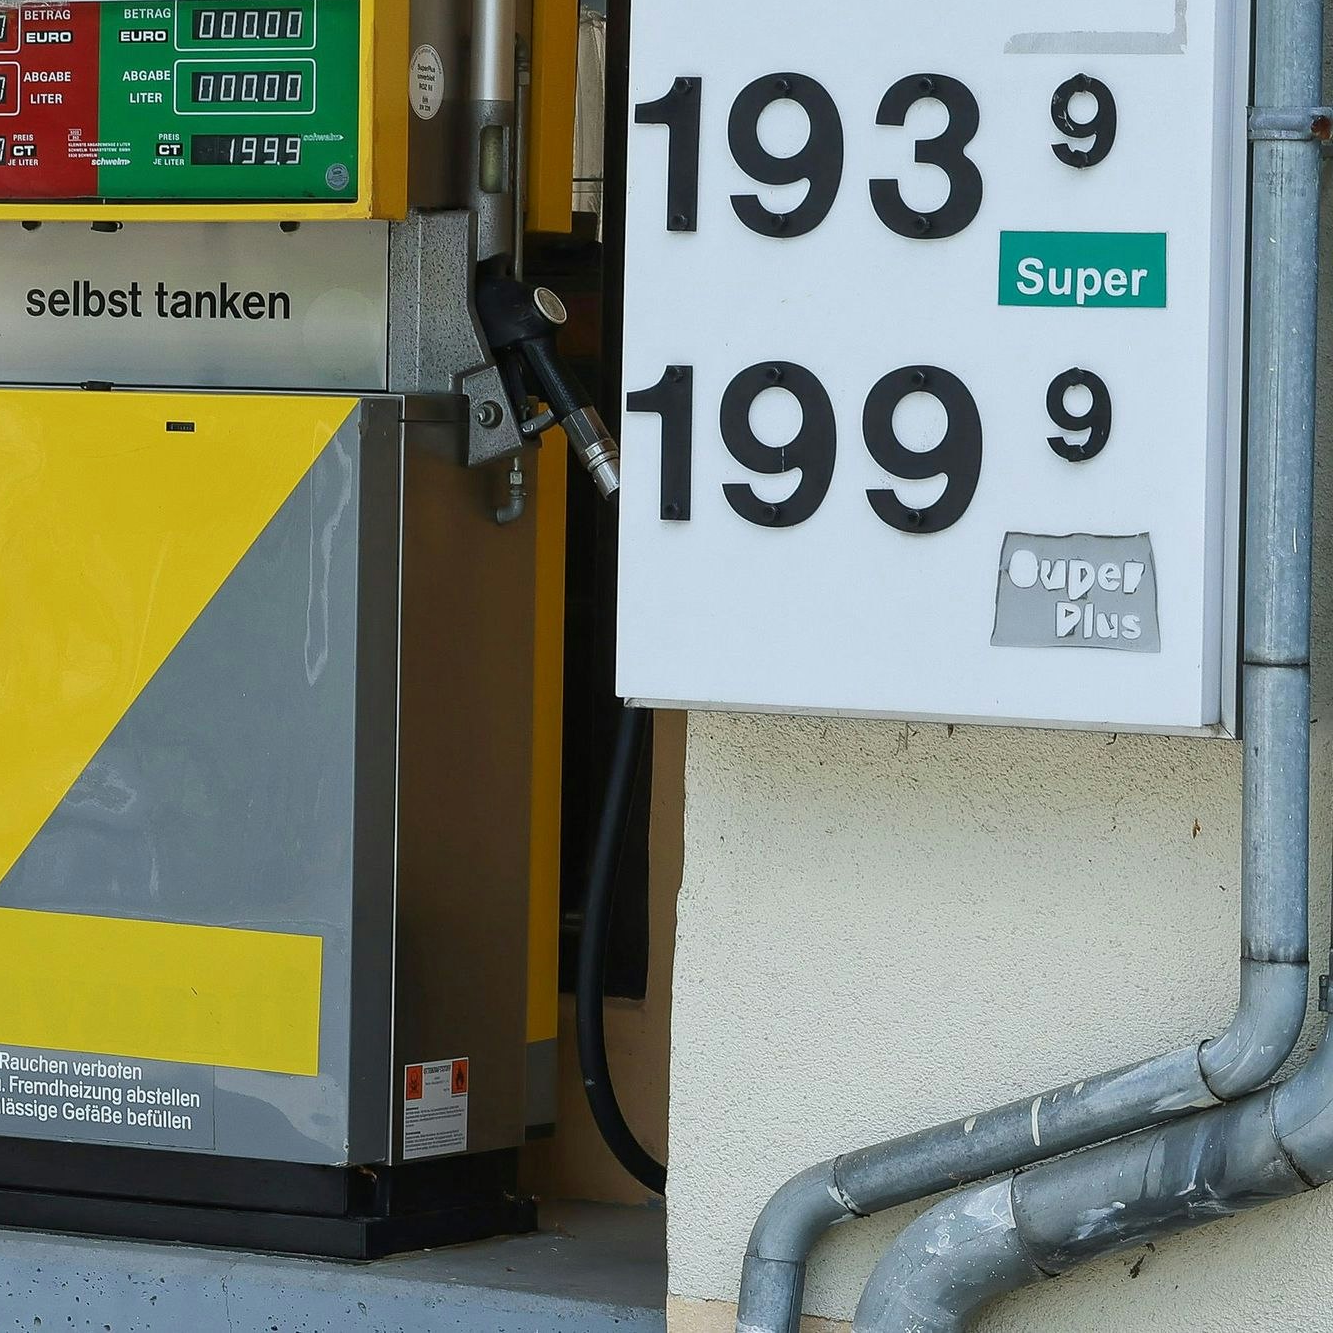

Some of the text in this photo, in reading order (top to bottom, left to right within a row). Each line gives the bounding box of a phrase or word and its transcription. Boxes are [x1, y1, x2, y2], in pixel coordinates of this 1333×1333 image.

[24, 10, 71, 21] BETRAG
[124, 8, 171, 19] BETRAG
[26, 31, 72, 43] EURO
[120, 31, 167, 42] EURO
[24, 72, 71, 82] ABGABE
[122, 70, 171, 81] ABGABE
[30, 93, 63, 104] LITER
[129, 92, 163, 104] LITER
[158, 133, 180, 141] PREIS
[13, 146, 35, 156] CT
[159, 144, 181, 155] CT
[91, 157, 128, 166] schwelm
[634, 71, 1118, 241] 193 9
[18, 158, 39, 166] LITER
[153, 158, 185, 166] JE LITER
[1016, 257, 1148, 305] Super
[26, 280, 291, 320] selbst tanken
[625, 359, 1112, 535] 199 9
[1056, 601, 1142, 640] Plus
[72, 1058, 142, 1081] verboten
[9, 1075, 122, 1104] Fremdheizung
[126, 1086, 201, 1108] abstellen
[62, 1102, 122, 1124] Gefäße
[126, 1108, 192, 1130] befüllen
